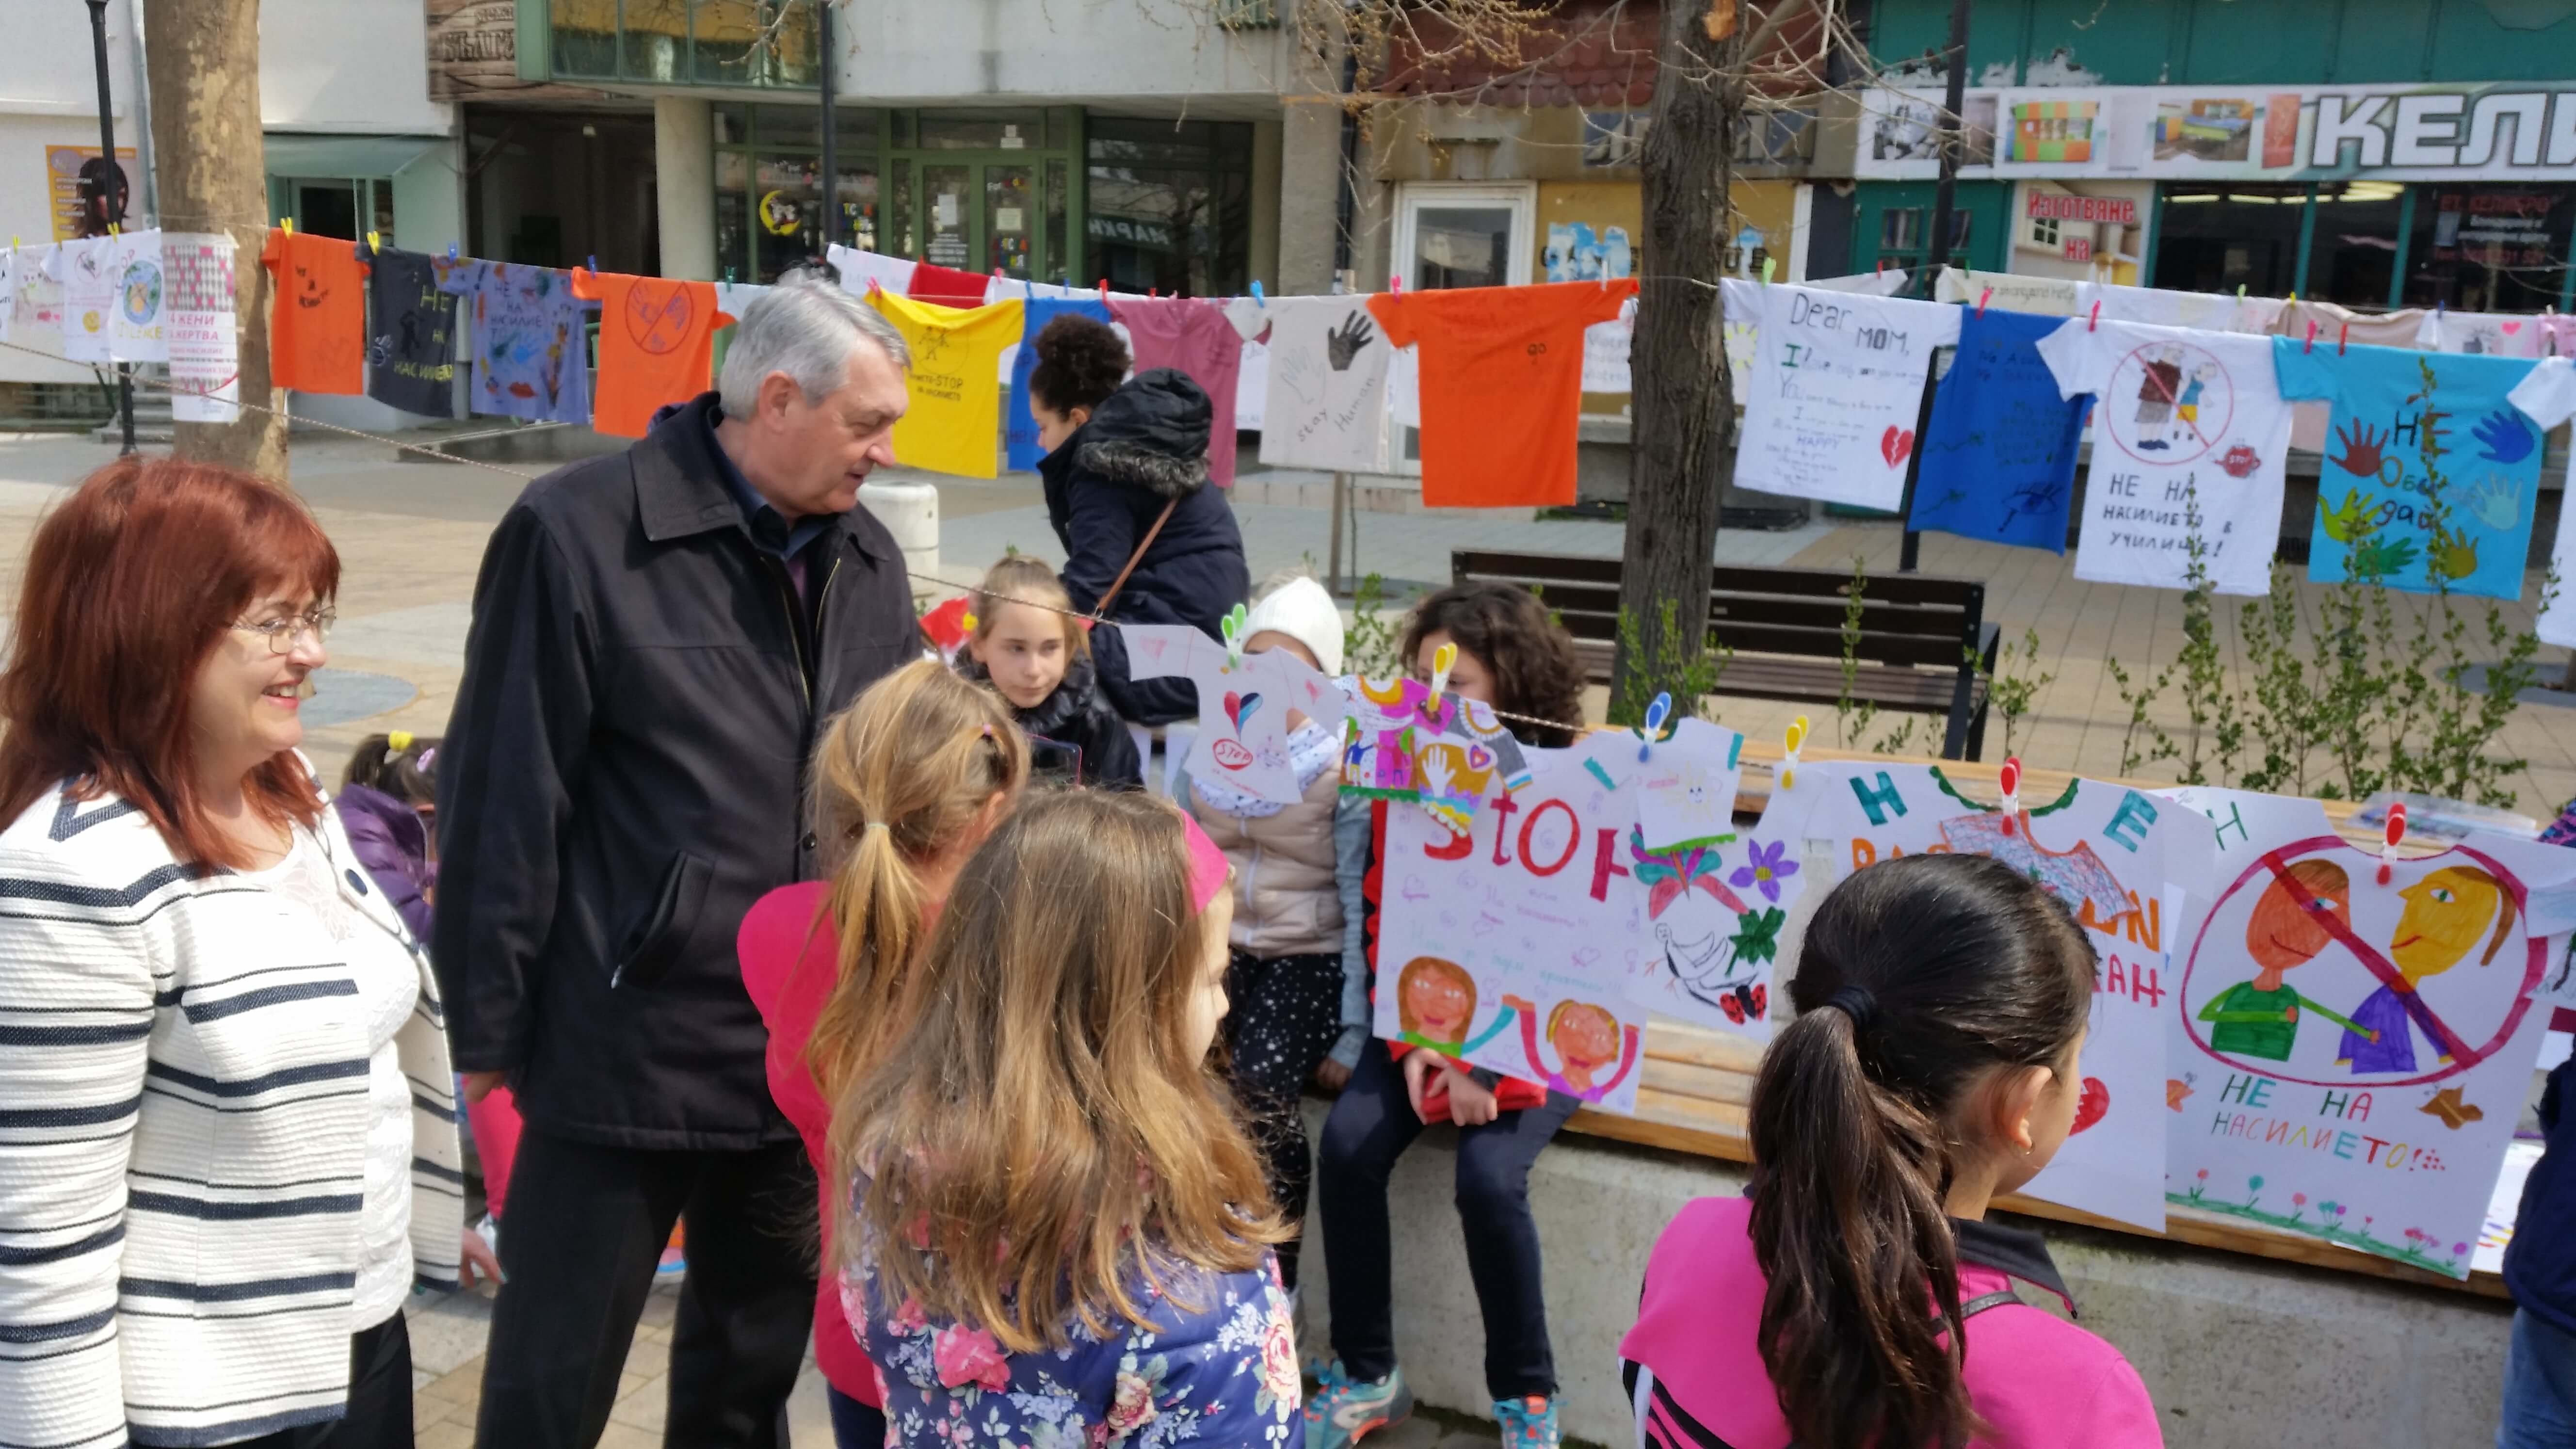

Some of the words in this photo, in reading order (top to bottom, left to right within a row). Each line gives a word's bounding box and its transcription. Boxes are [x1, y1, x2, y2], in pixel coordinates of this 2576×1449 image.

[1791, 293, 1852, 329] Dear
[1334, 378, 1376, 432] Human
[2109, 473, 2140, 497] НЕ
[2103, 505, 2203, 528] НАСИЛИЕТО
[1218, 744, 1251, 761] STOP
[2220, 1074, 2276, 1109] НЕ
[2319, 1090, 2372, 1122] НА
